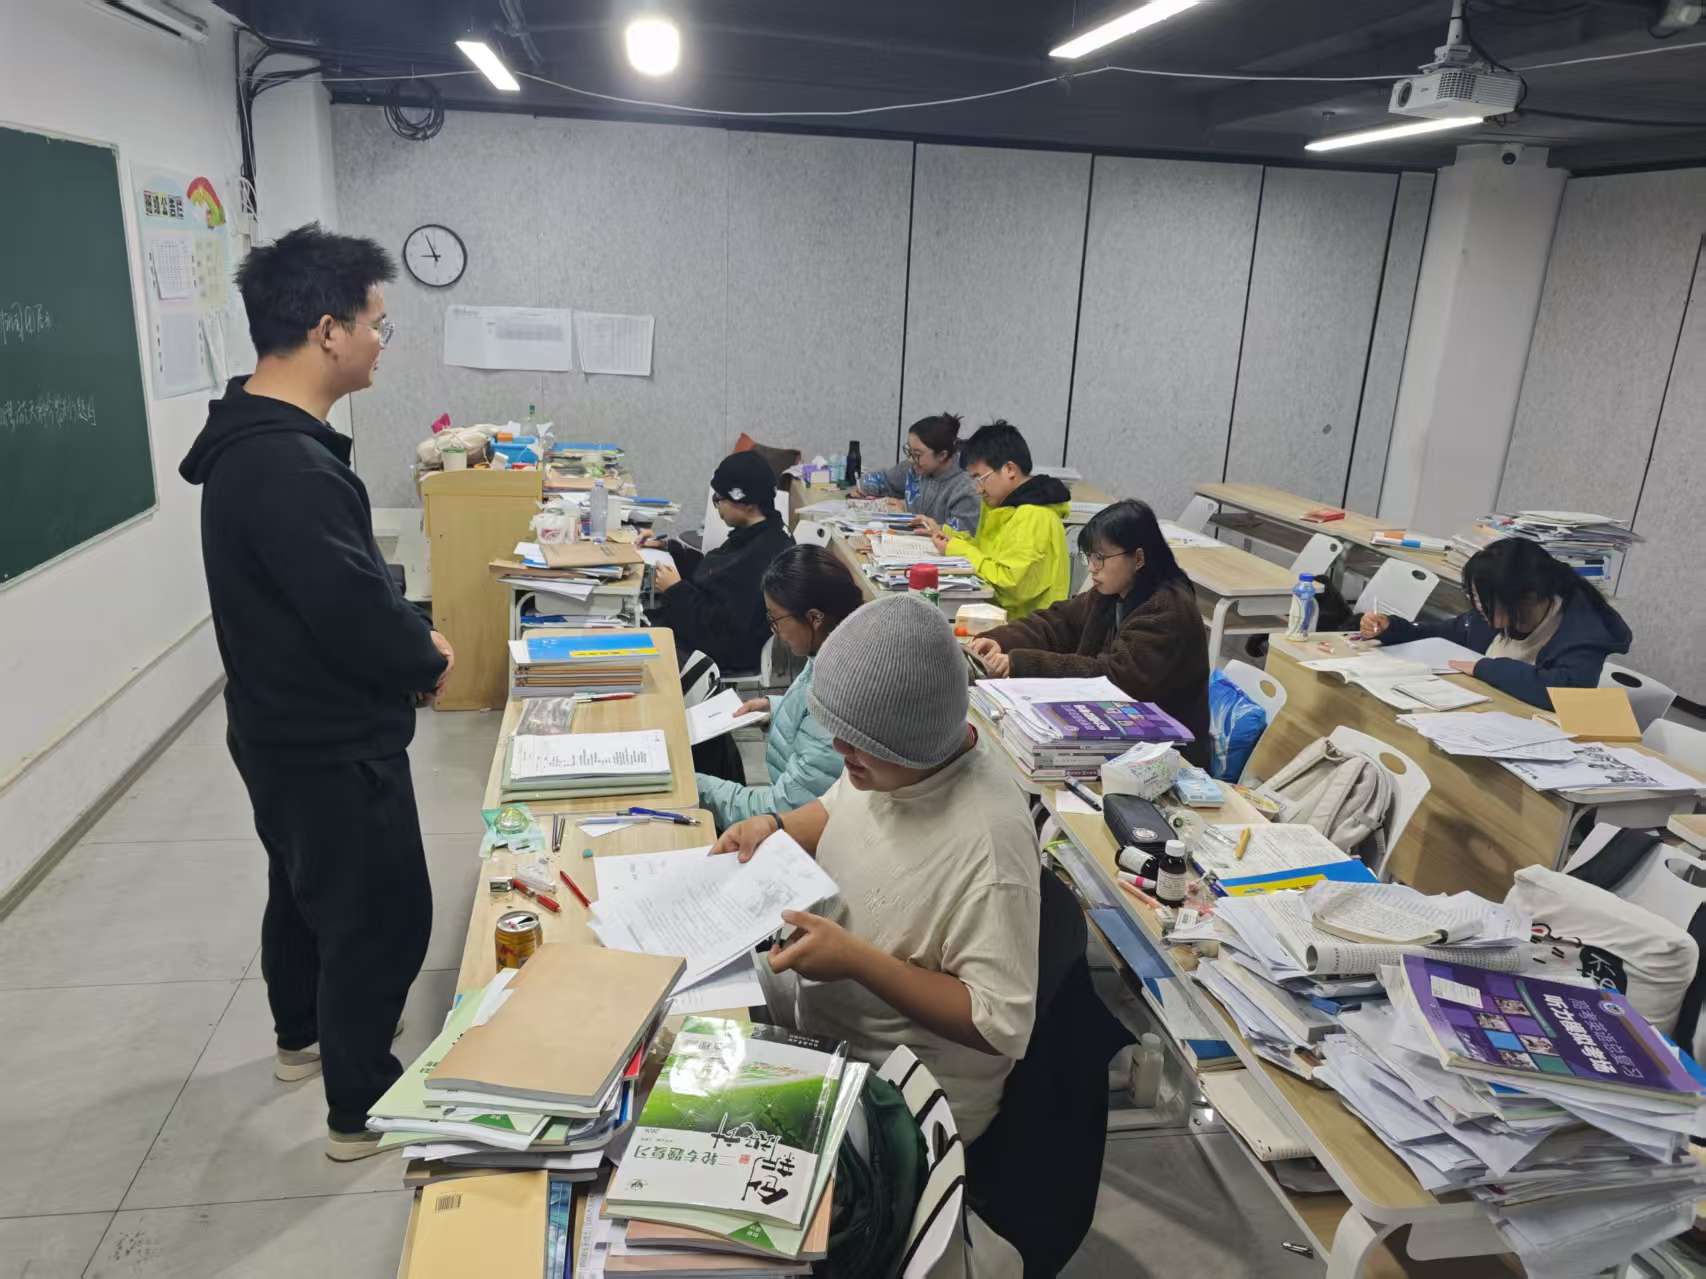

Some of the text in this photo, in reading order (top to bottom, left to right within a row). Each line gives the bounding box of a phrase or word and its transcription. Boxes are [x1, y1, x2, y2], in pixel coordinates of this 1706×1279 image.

[1542, 993, 1618, 1074] 听力模拟考场
